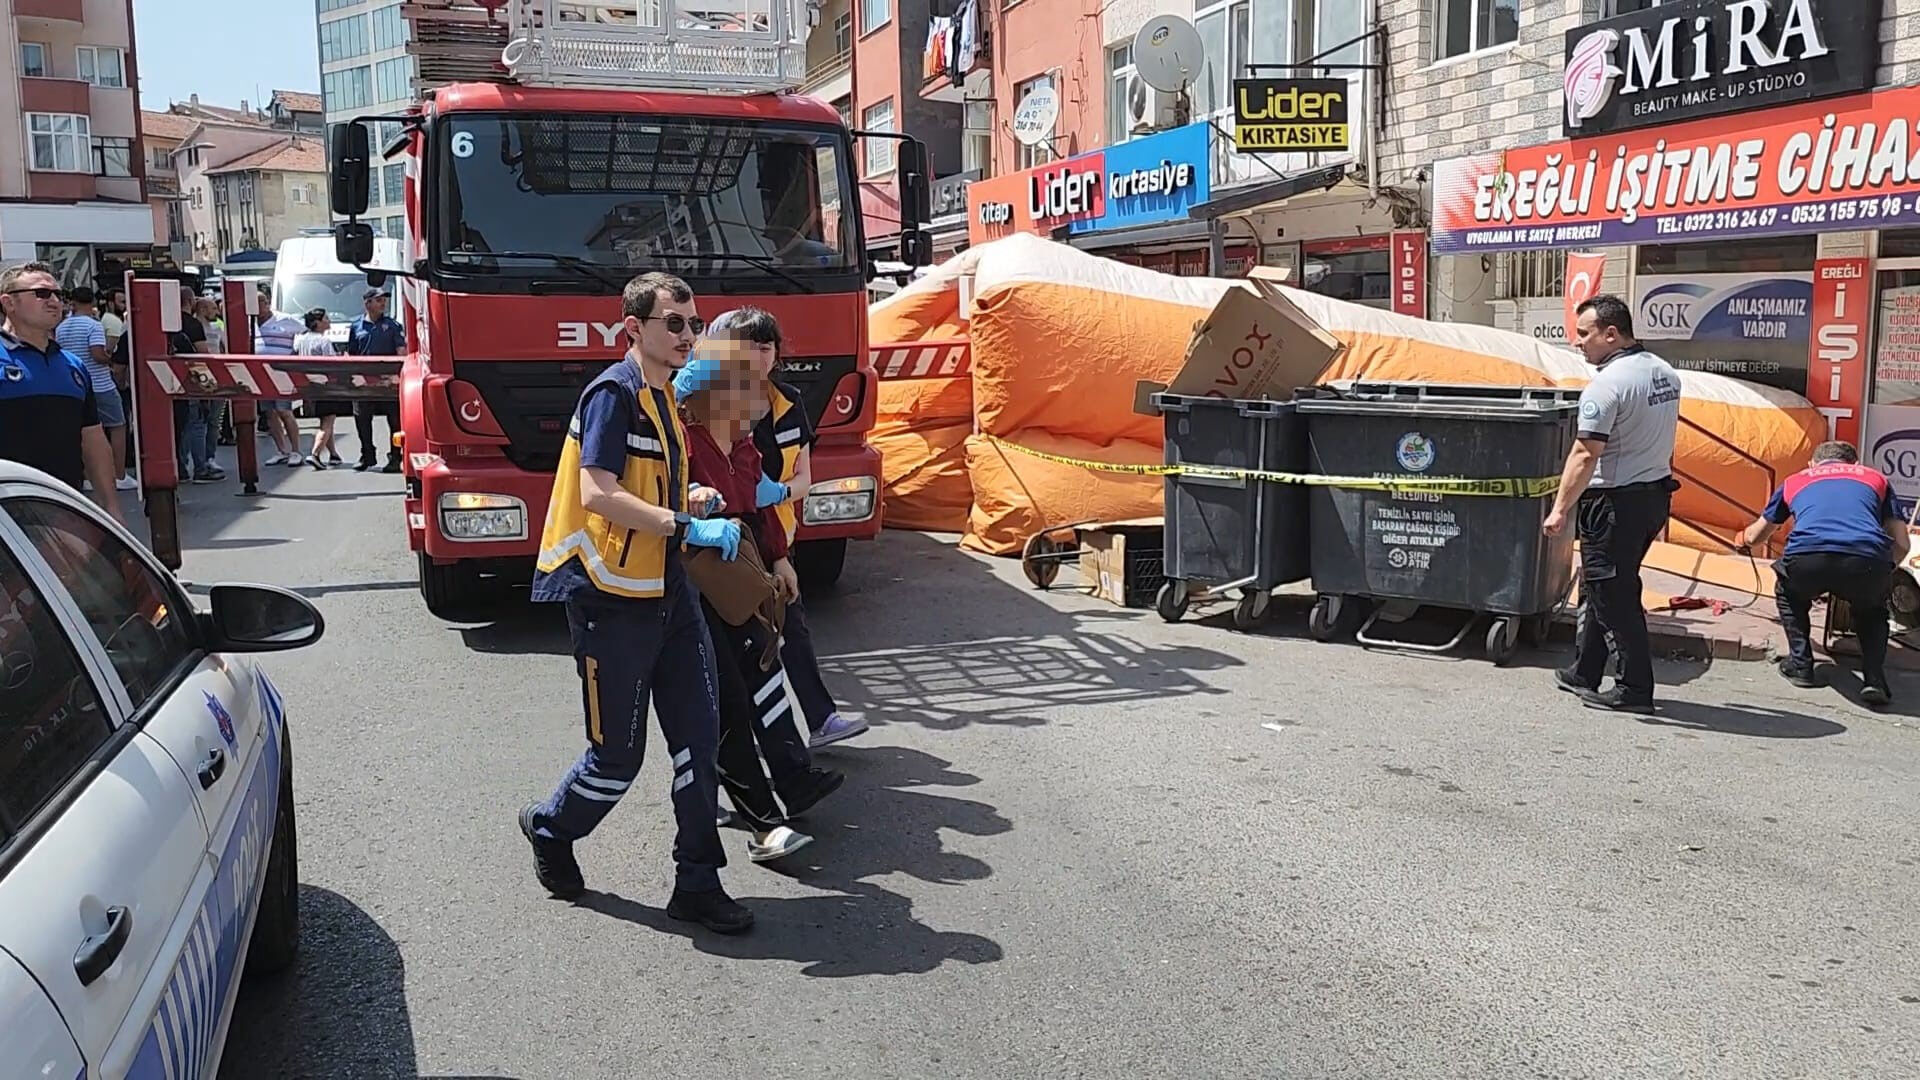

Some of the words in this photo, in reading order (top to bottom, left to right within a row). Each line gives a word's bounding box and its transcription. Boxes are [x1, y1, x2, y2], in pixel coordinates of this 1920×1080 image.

[1240, 87, 1342, 119] Lider
[1634, 95, 1679, 116] BEAUTY
[1681, 89, 1716, 107] MAKE
[1728, 82, 1745, 99] UP
[452, 131, 475, 158] 6
[1028, 168, 1095, 220] Lider
[1475, 149, 1597, 223] EREĞLİ
[1606, 139, 1764, 224] İŞİTME
[979, 201, 1009, 225] kitap
[1657, 216, 1682, 234] TEL:
[1684, 214, 1713, 232] 0372
[1715, 211, 1738, 230] 316
[1740, 209, 1757, 227] 24
[1759, 207, 1778, 225] 67
[1791, 203, 1825, 223] 0532
[1830, 201, 1855, 221] 155
[1859, 199, 1879, 218] 75
[1466, 231, 1513, 245] UYGULAMA
[1515, 229, 1527, 242] VE
[1529, 228, 1555, 244] SATIŞ
[1821, 264, 1862, 279] EREĞLİ
[1648, 302, 1691, 328] SGK
[1728, 298, 1806, 320] ANLAŞMAMIZ
[1743, 320, 1786, 338] VARDIR
[1678, 359, 1705, 370] HAYAT
[1749, 360, 1780, 374] DEĞER
[1881, 448, 1920, 478] SG
[1411, 510, 1432, 521] SAYGI
